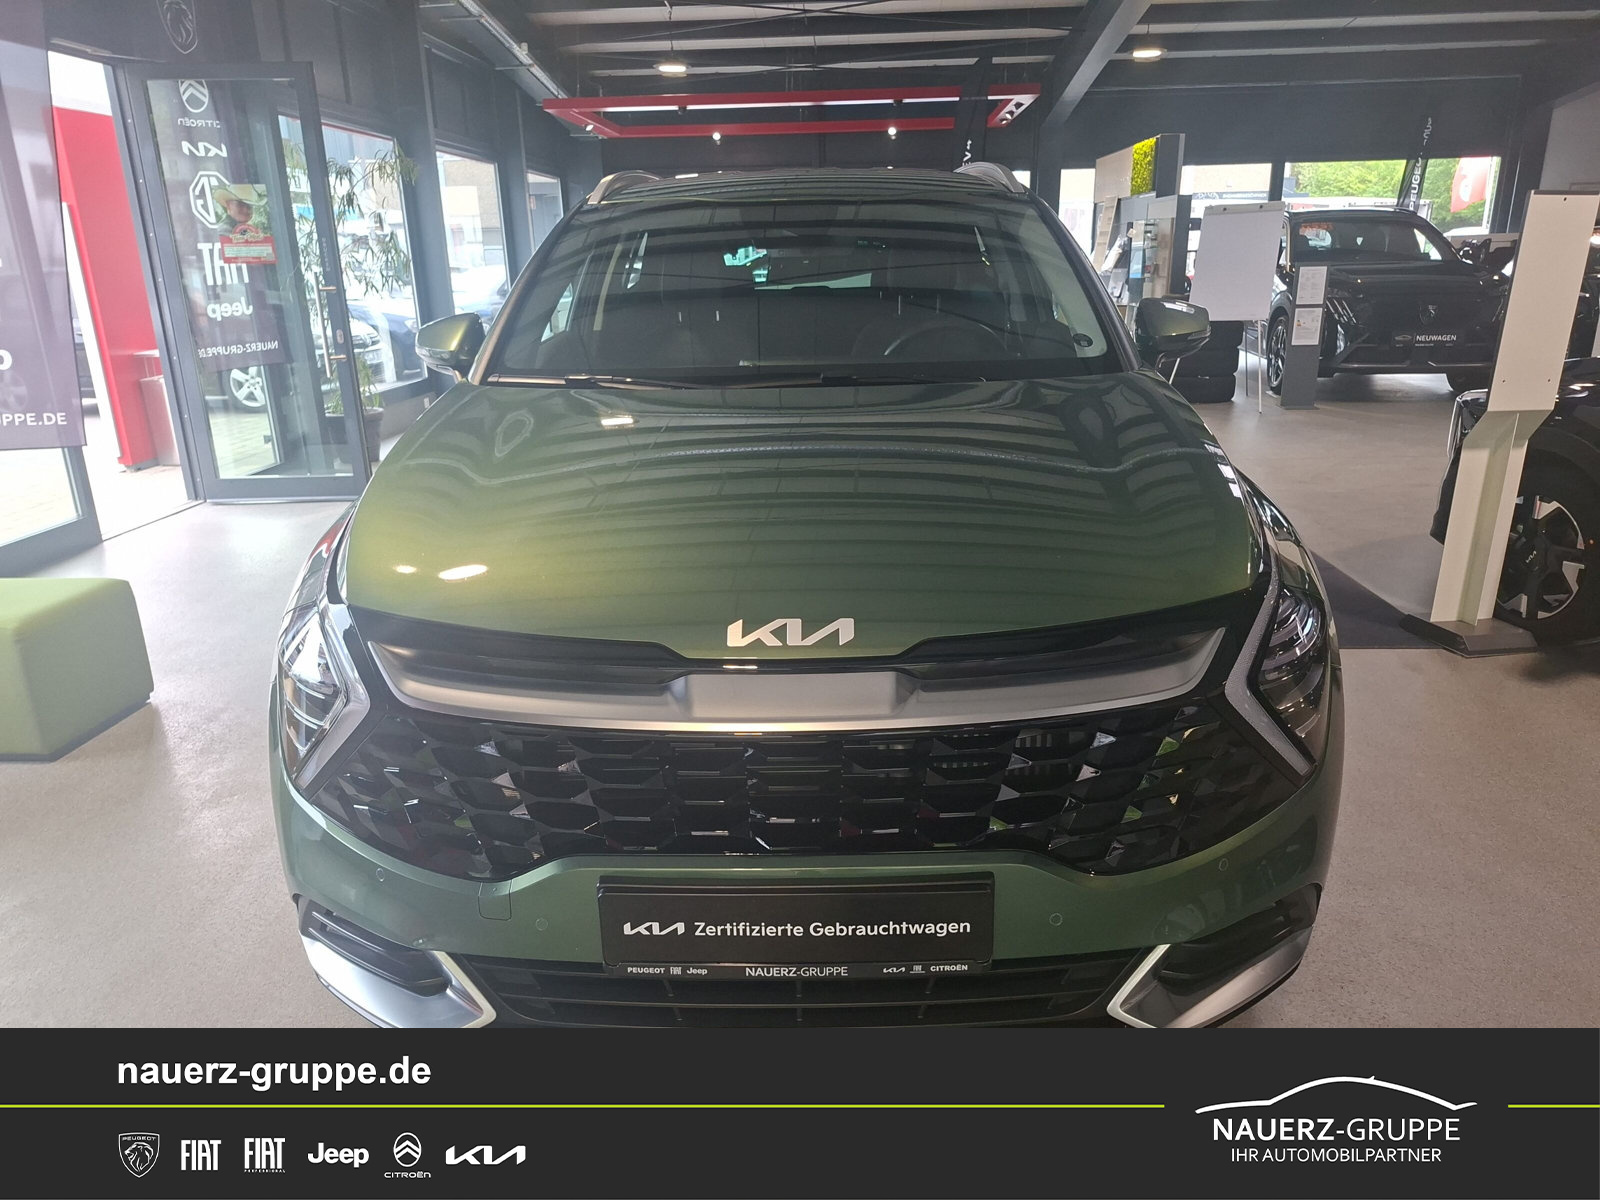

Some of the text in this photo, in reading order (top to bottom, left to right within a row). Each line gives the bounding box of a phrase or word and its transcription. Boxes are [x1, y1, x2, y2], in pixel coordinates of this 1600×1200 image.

[1416, 334, 1457, 342] NEUWAGEN
[0, 412, 68, 426] PPE.DE
[726, 617, 855, 647] KIA
[623, 920, 971, 937] KIA Zertifizierte Gebrauchtwagen
[627, 966, 666, 974] PEUGEOT
[686, 967, 708, 976] Jeep
[745, 966, 849, 977] NAUERZ-GRUPPE
[883, 966, 906, 974] KIA
[930, 963, 968, 972] CITROËN
